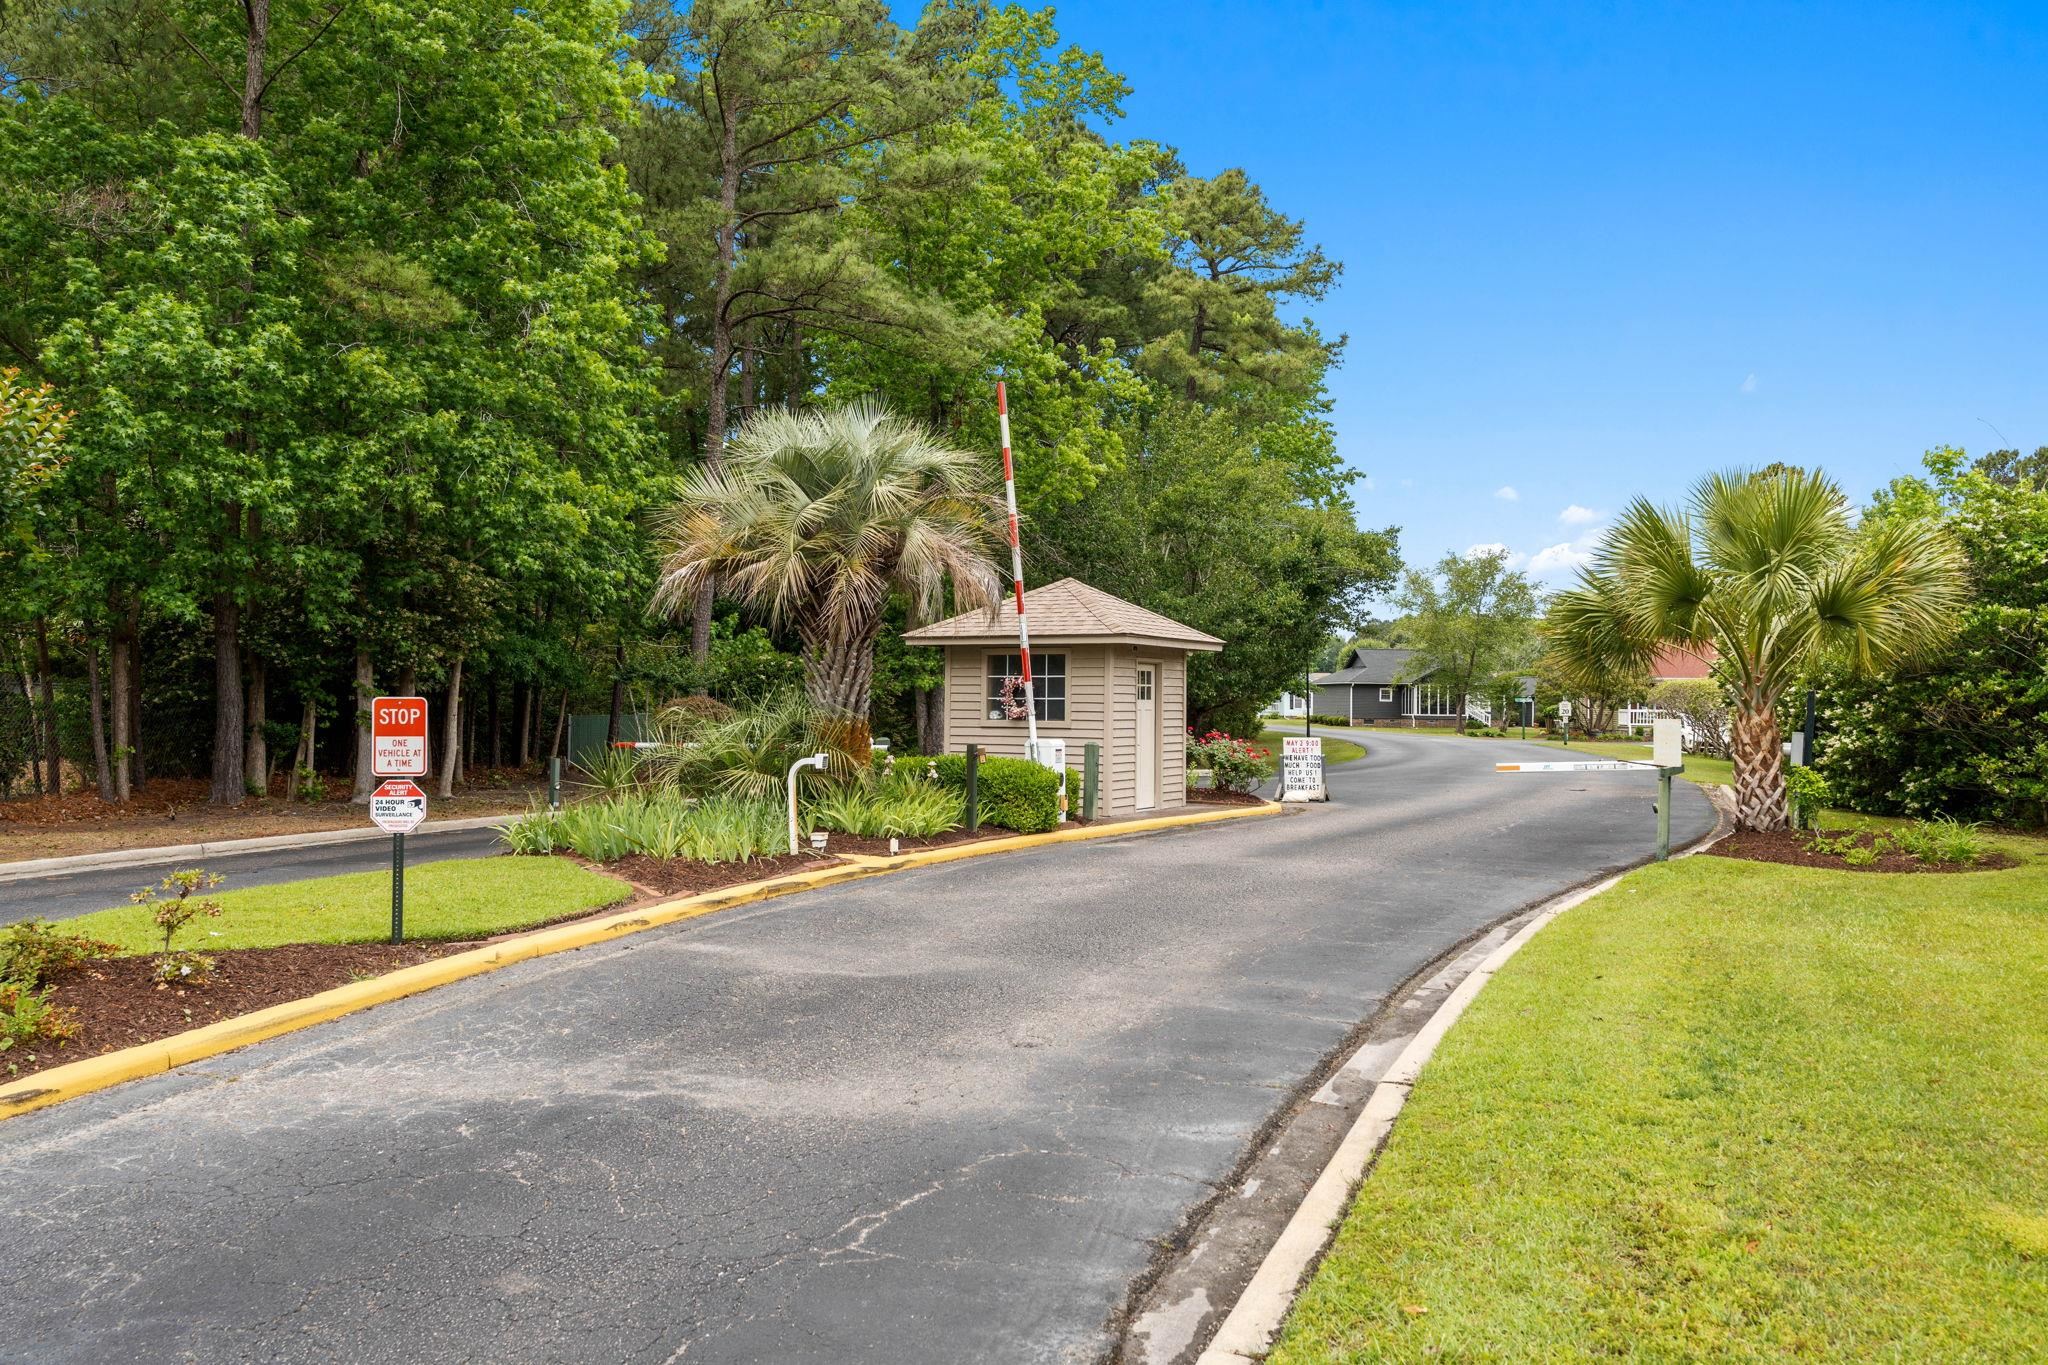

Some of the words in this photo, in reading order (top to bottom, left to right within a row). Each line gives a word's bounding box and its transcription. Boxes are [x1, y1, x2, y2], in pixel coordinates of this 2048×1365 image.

[379, 708, 420, 725] STOP
[392, 739, 408, 747] ONE
[378, 749, 410, 758] VEHICLE
[413, 749, 422, 758] AT
[387, 759, 392, 768] A
[395, 759, 412, 768] TIME
